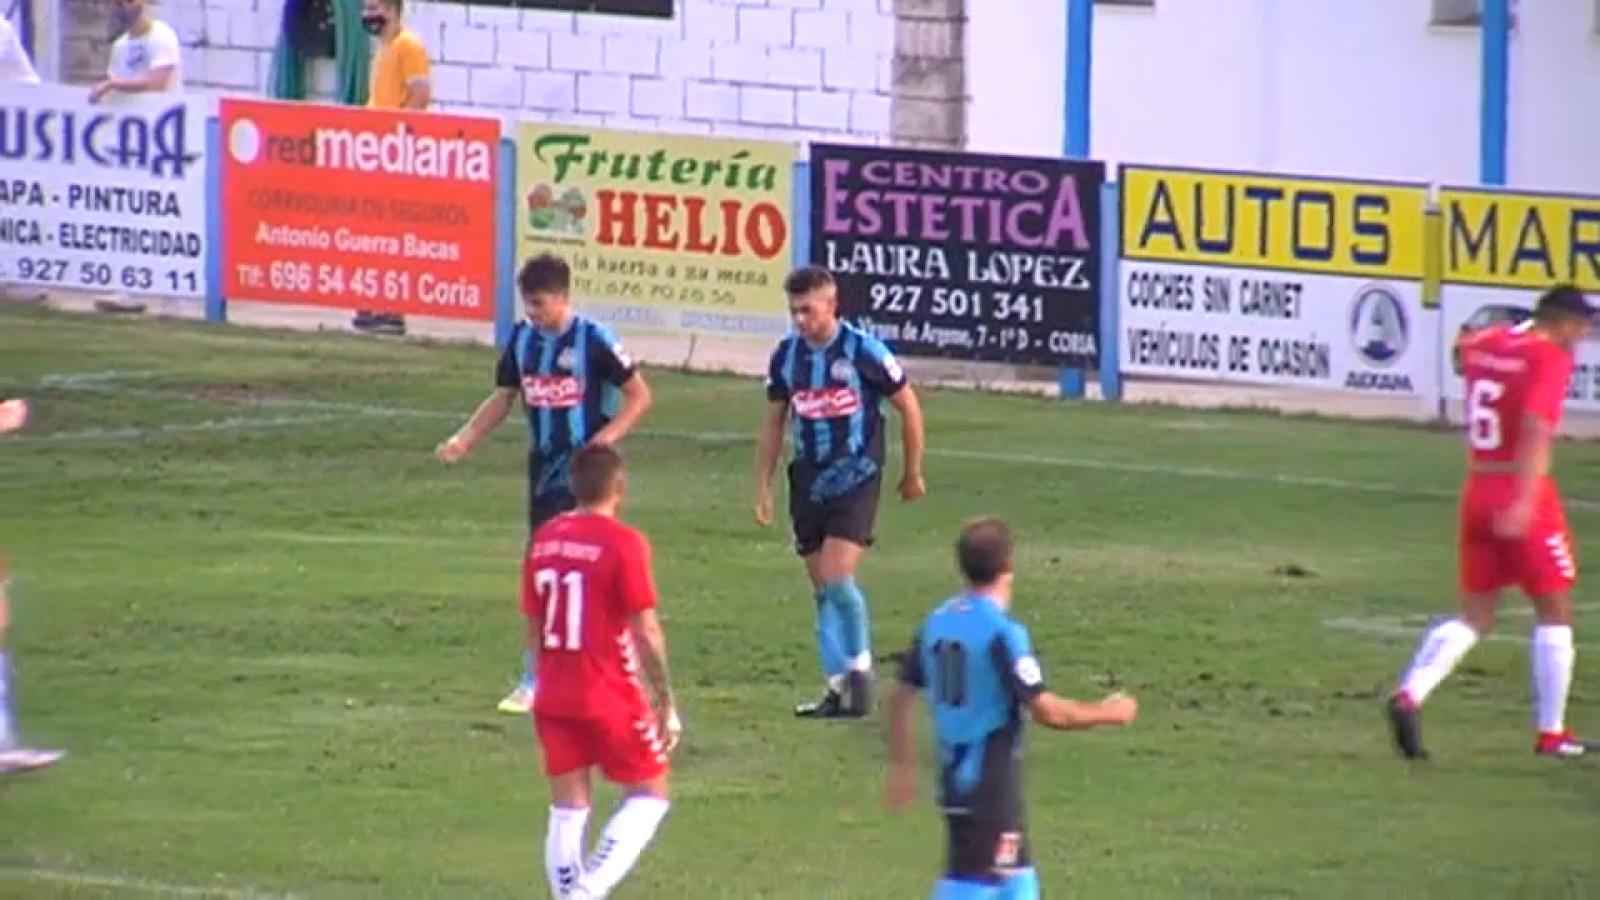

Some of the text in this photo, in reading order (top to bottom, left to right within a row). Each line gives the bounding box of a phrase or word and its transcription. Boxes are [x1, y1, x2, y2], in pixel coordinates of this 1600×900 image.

[534, 134, 777, 190] Frutería
[861, 160, 1049, 195] CENTRO
[69, 184, 181, 217] PINTURA
[595, 189, 787, 258] HELIO
[823, 159, 1090, 249] ESTETICA
[1139, 180, 1390, 265] AUTOS
[59, 223, 201, 258] ELECTRICIDAD
[256, 221, 459, 261] Antonio Guerra Bacas
[17, 257, 197, 292] 927 50 63 11
[270, 261, 311, 292] 696
[318, 264, 344, 295] 54
[350, 268, 378, 299] 45
[384, 271, 409, 300] 61
[418, 273, 480, 307] Coria
[826, 240, 1090, 290] LAURA LOPEZ
[870, 284, 1043, 322] 927 501 341
[1128, 271, 1303, 320] COCHES SIN CARNET
[1229, 335, 1249, 373] DE
[1258, 333, 1331, 378] OCASIÓN
[1470, 379, 1505, 450] 6
[534, 567, 584, 651] 21
